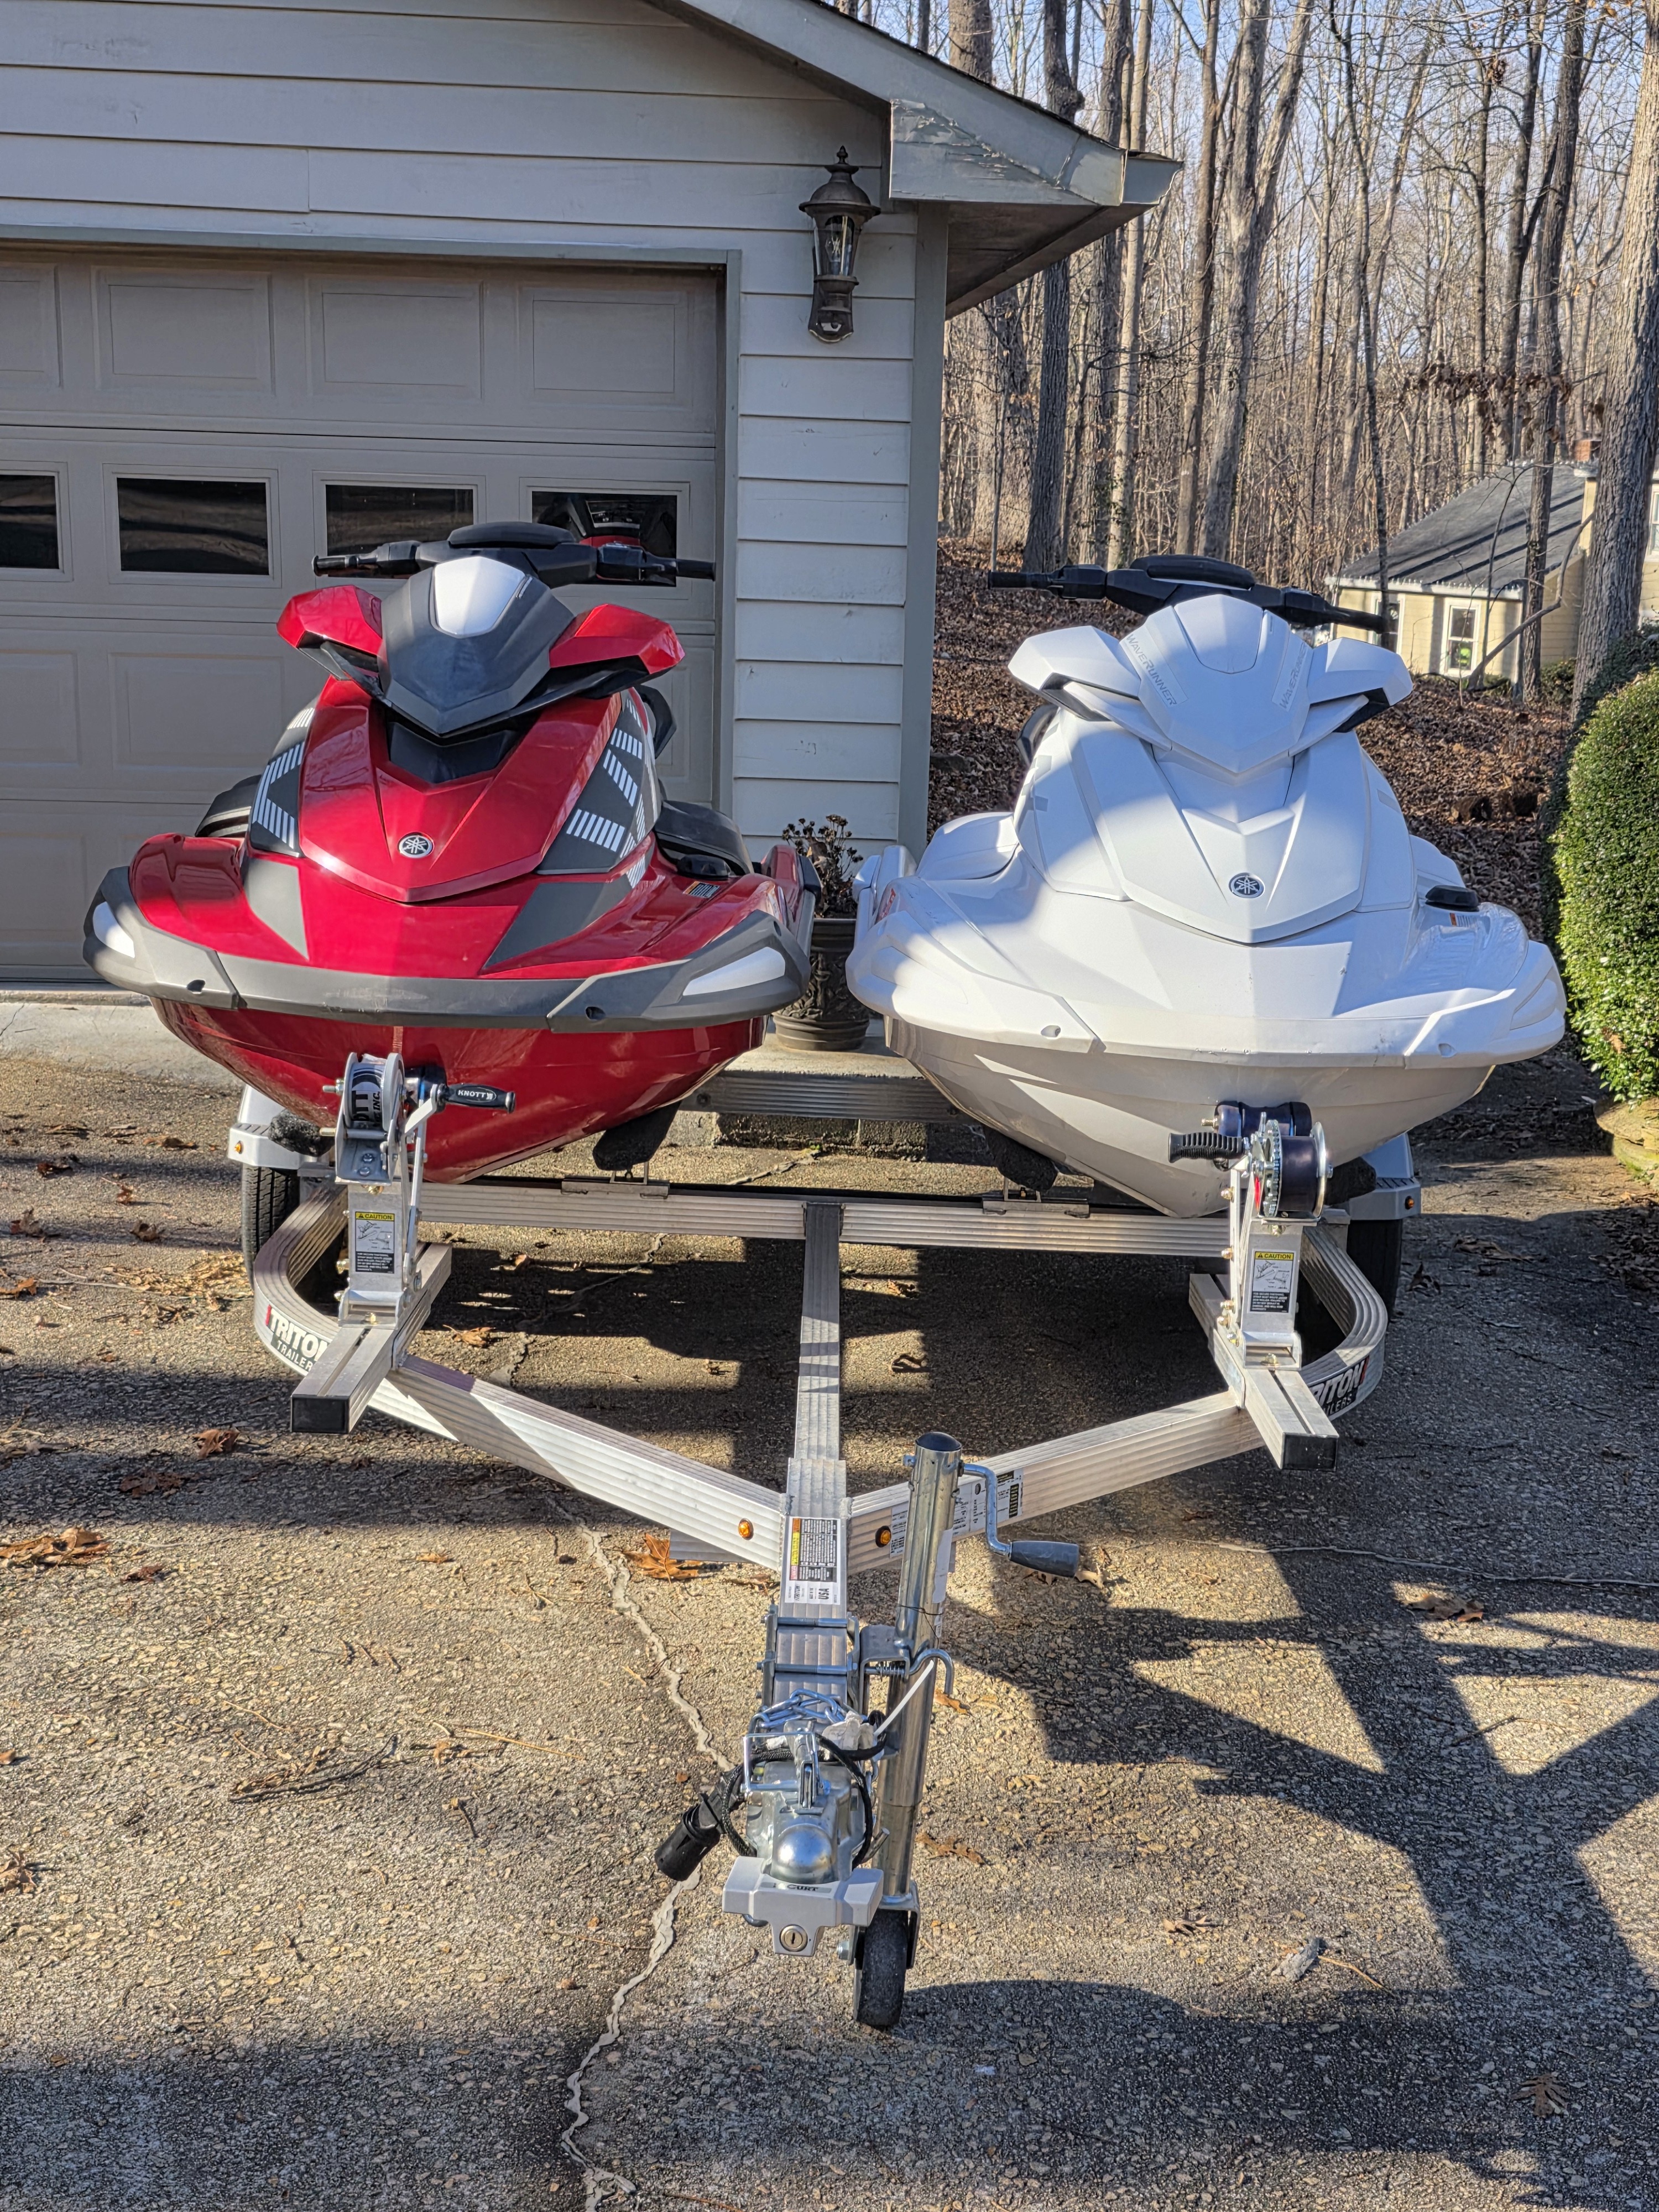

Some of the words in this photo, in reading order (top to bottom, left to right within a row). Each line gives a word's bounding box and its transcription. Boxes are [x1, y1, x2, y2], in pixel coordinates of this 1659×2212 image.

[458, 1089, 486, 1098] KNOTT
[1308, 1359, 1365, 1407] RITON
[818, 1588, 830, 1600] USA
